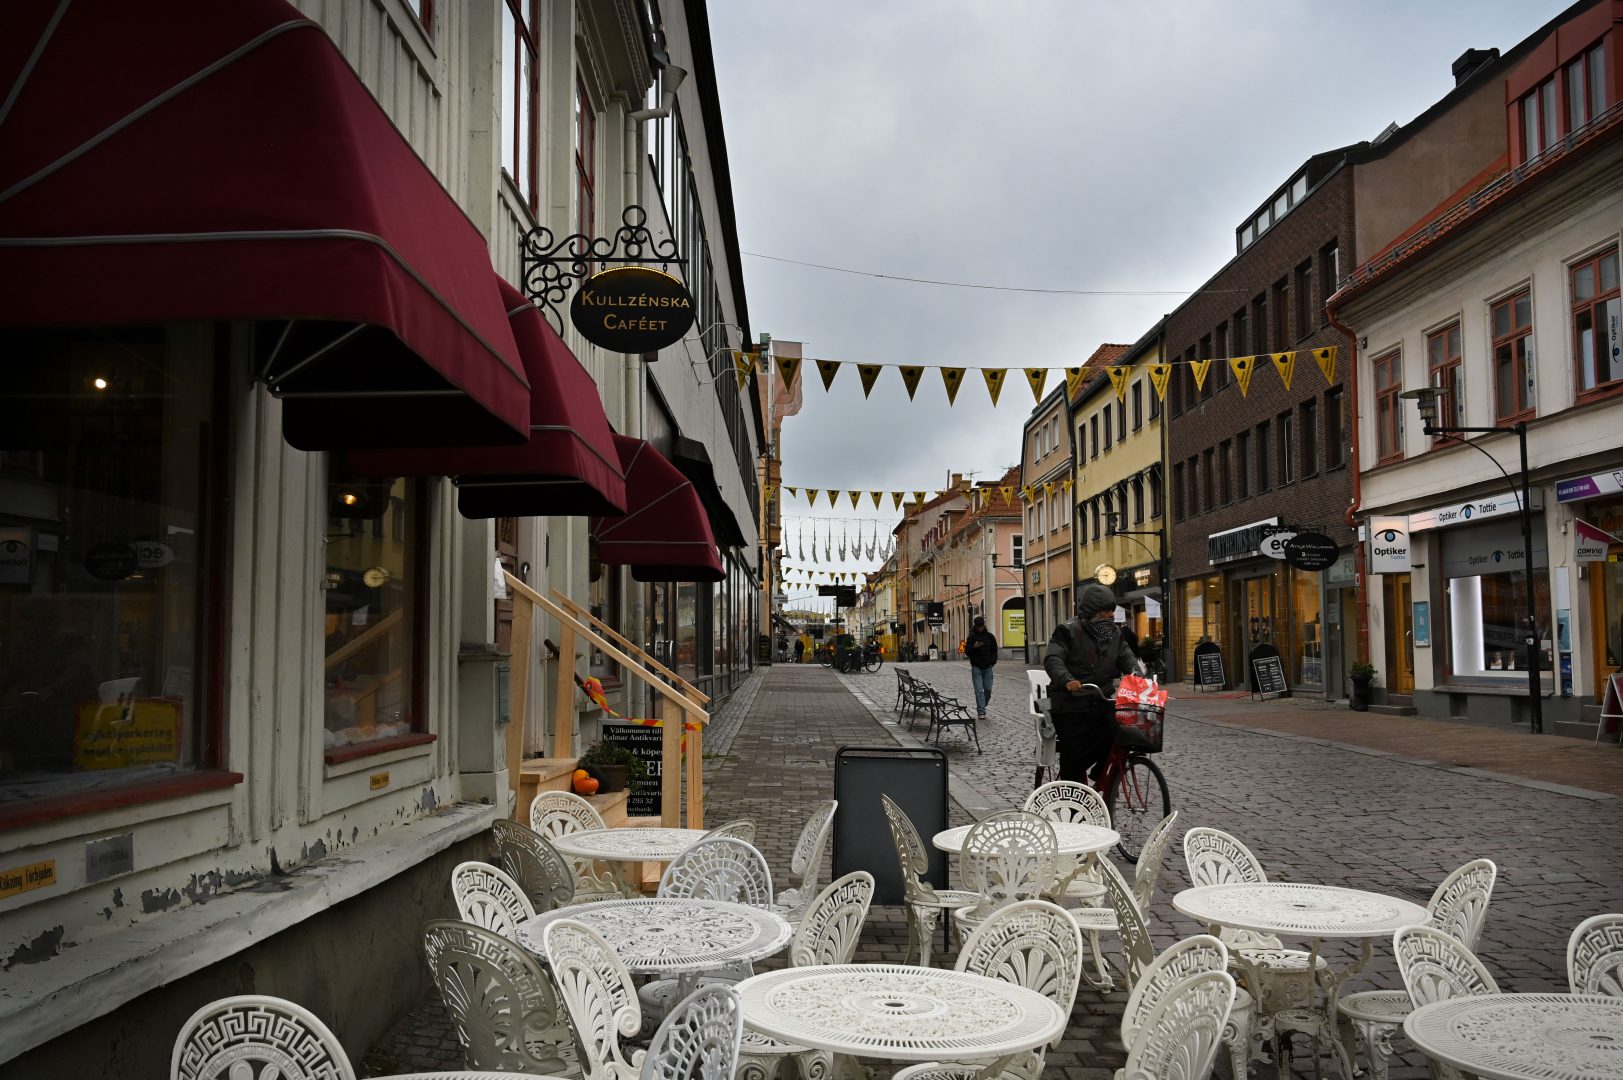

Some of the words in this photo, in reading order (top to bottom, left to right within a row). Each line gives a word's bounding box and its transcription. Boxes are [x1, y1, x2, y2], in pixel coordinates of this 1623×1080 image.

[1438, 512, 1457, 522] Optiker
[1478, 502, 1497, 514] Tottie
[1374, 548, 1407, 559] Optiker
[1468, 556, 1489, 566] Optiker
[1507, 550, 1525, 560] Tottie
[0, 874, 23, 891] Rökning
[26, 863, 53, 885] förbjuden
